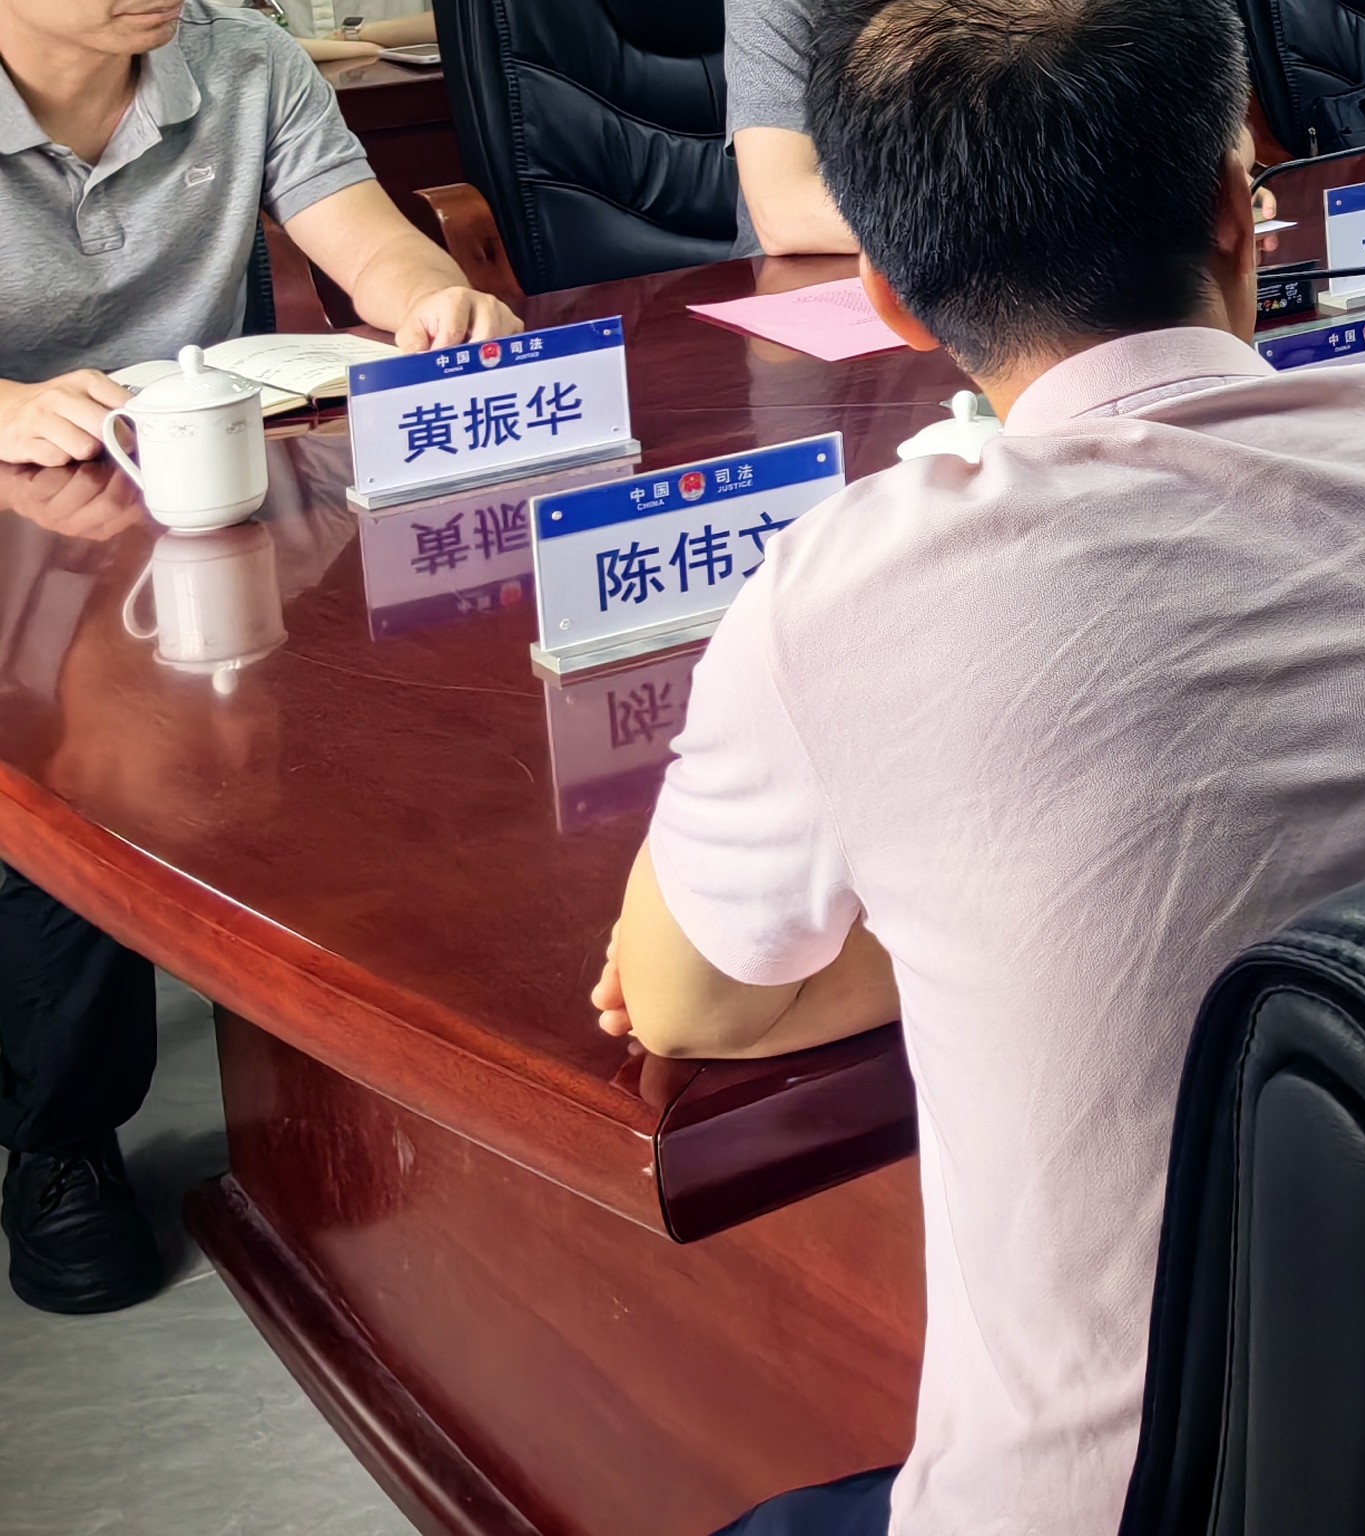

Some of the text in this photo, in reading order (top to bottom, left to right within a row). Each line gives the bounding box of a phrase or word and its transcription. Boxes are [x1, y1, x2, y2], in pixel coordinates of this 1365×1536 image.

[436, 337, 544, 368] 中国 司法
[1329, 329, 1356, 347] 中国
[398, 381, 583, 463] 黄振华
[630, 464, 753, 504] 中国 司法
[637, 479, 753, 511] CHINA JUSTICE
